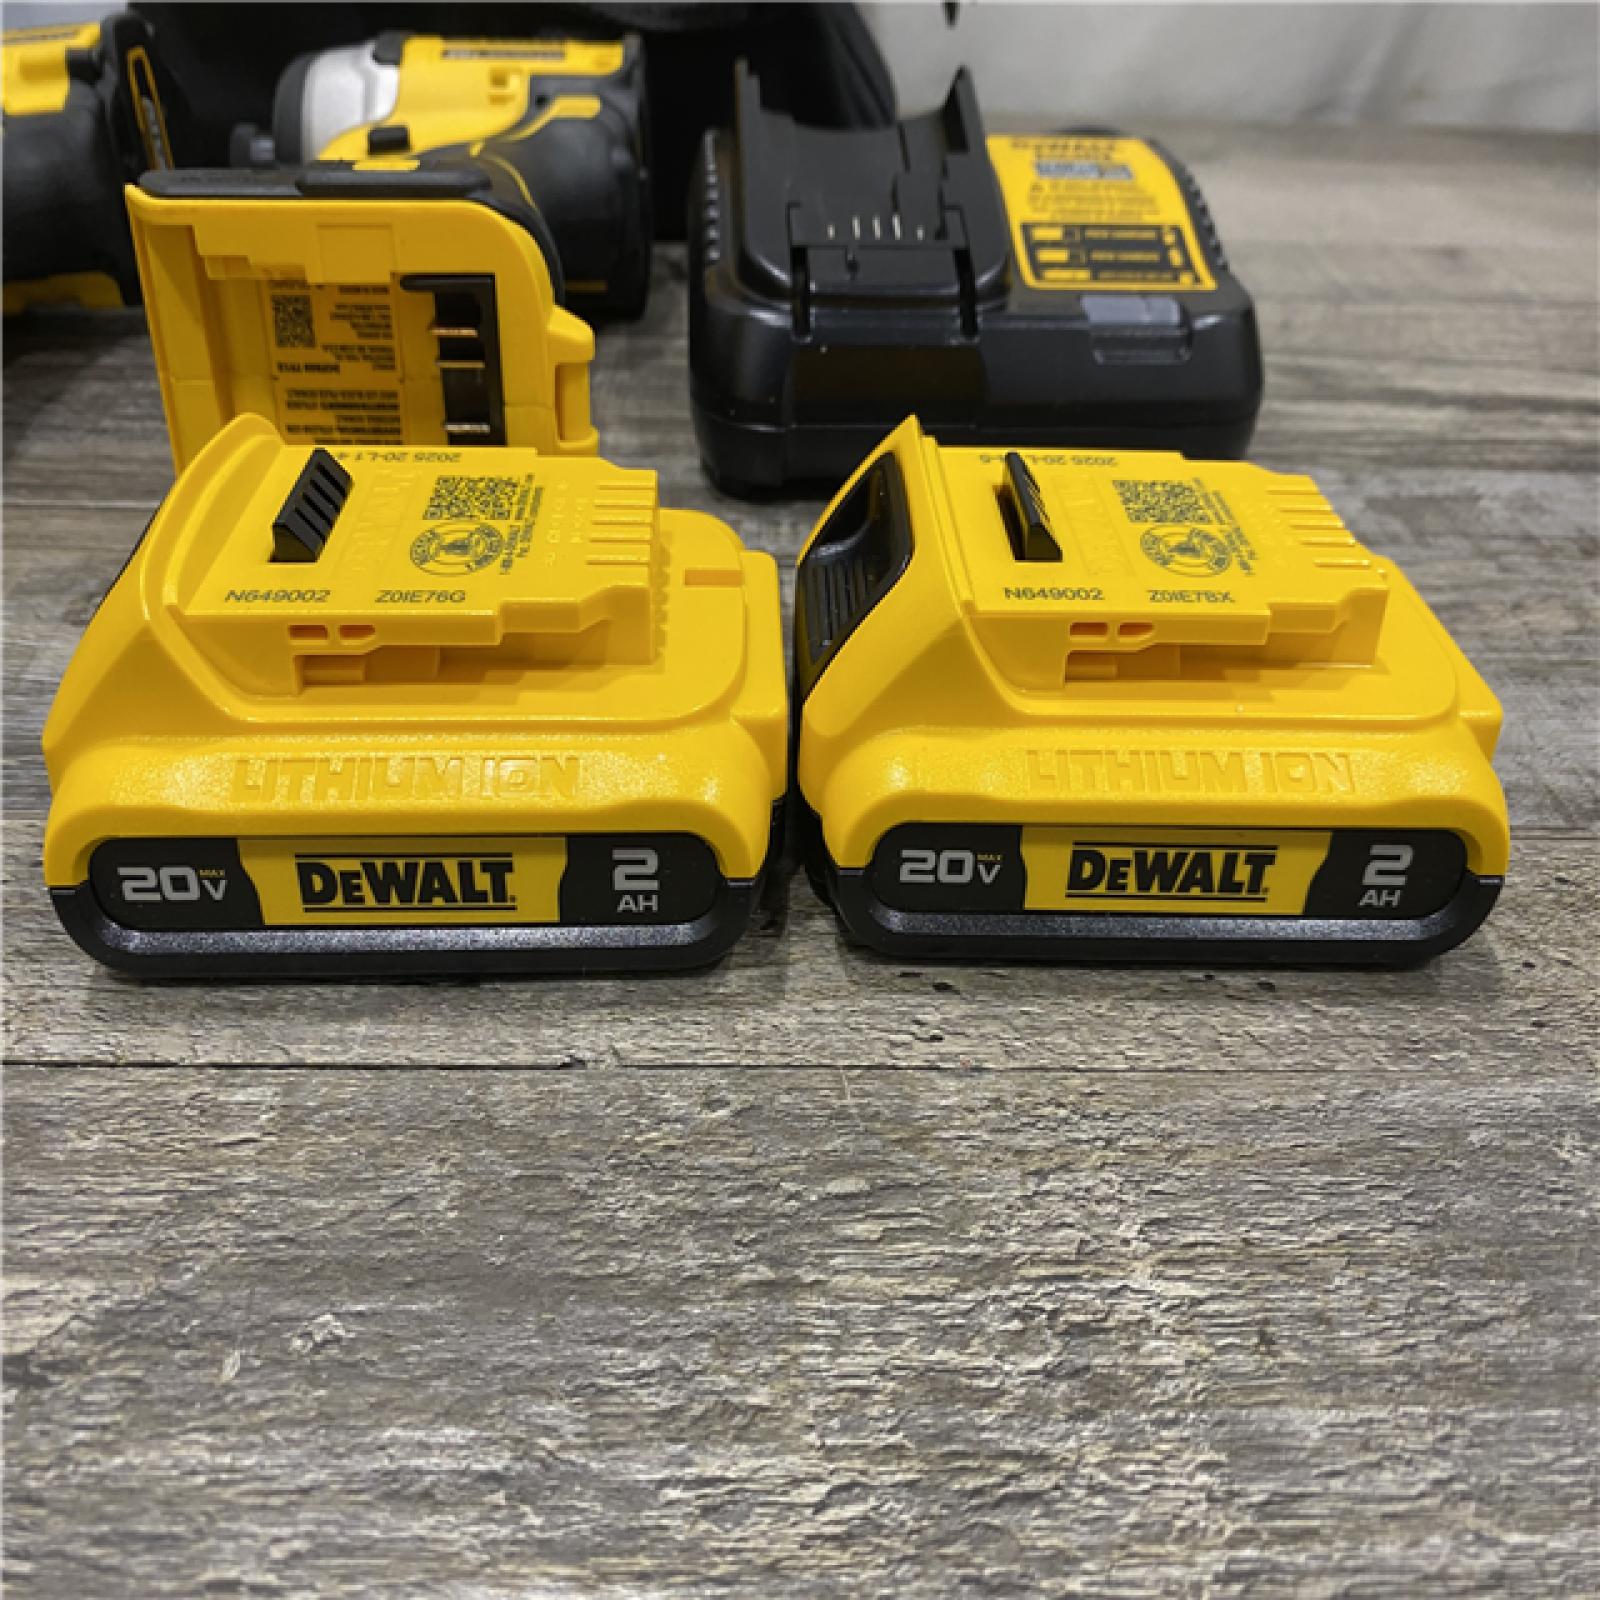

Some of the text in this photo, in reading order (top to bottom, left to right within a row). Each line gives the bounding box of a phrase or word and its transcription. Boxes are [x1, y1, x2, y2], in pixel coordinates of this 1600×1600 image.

[225, 589, 331, 603] N649002
[1004, 587, 1105, 601] N649002
[231, 755, 583, 802] LITHIUM ION
[1026, 750, 1354, 794] LITHIUM ION
[613, 849, 659, 891] 2
[1362, 844, 1414, 887] 2
[616, 893, 659, 913] AH
[1359, 887, 1400, 909] AH
